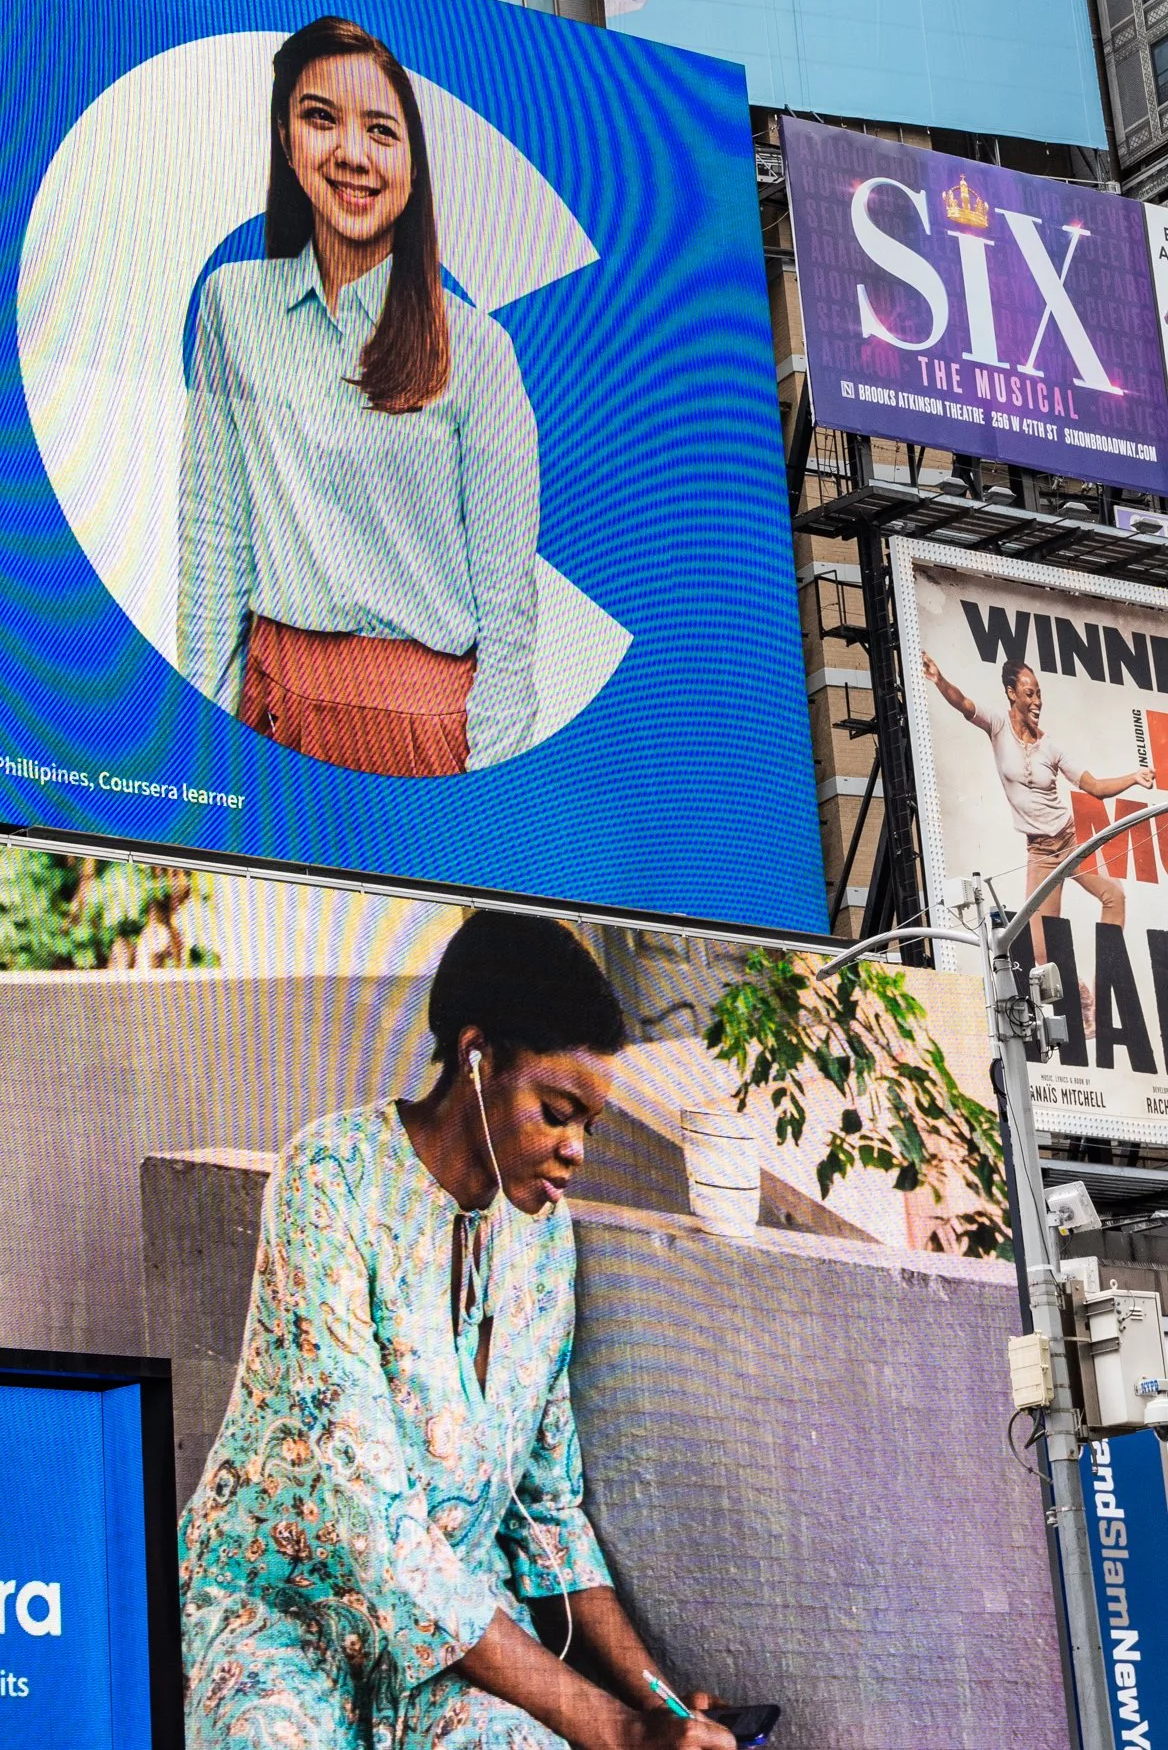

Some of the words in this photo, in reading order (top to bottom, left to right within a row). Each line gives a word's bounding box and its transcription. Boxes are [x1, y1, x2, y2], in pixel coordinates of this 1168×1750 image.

[850, 176, 1124, 395] SIX
[917, 355, 963, 394] THE
[975, 368, 1079, 420] MUSICAL
[858, 384, 896, 407] BROOKS
[898, 391, 944, 417] ATKINSON
[945, 401, 985, 425] THEATRE
[991, 411, 1009, 430] 256
[1011, 415, 1020, 432] W
[1022, 417, 1046, 439] 47TH
[1046, 425, 1058, 442] ST
[1064, 428, 1157, 462] SIXONBROADWAY.COM
[1132, 709, 1149, 768] INCLUDING
[98, 771, 179, 801] Coursera
[182, 783, 246, 810] learner
[1061, 1088, 1107, 1108] MITCHELL
